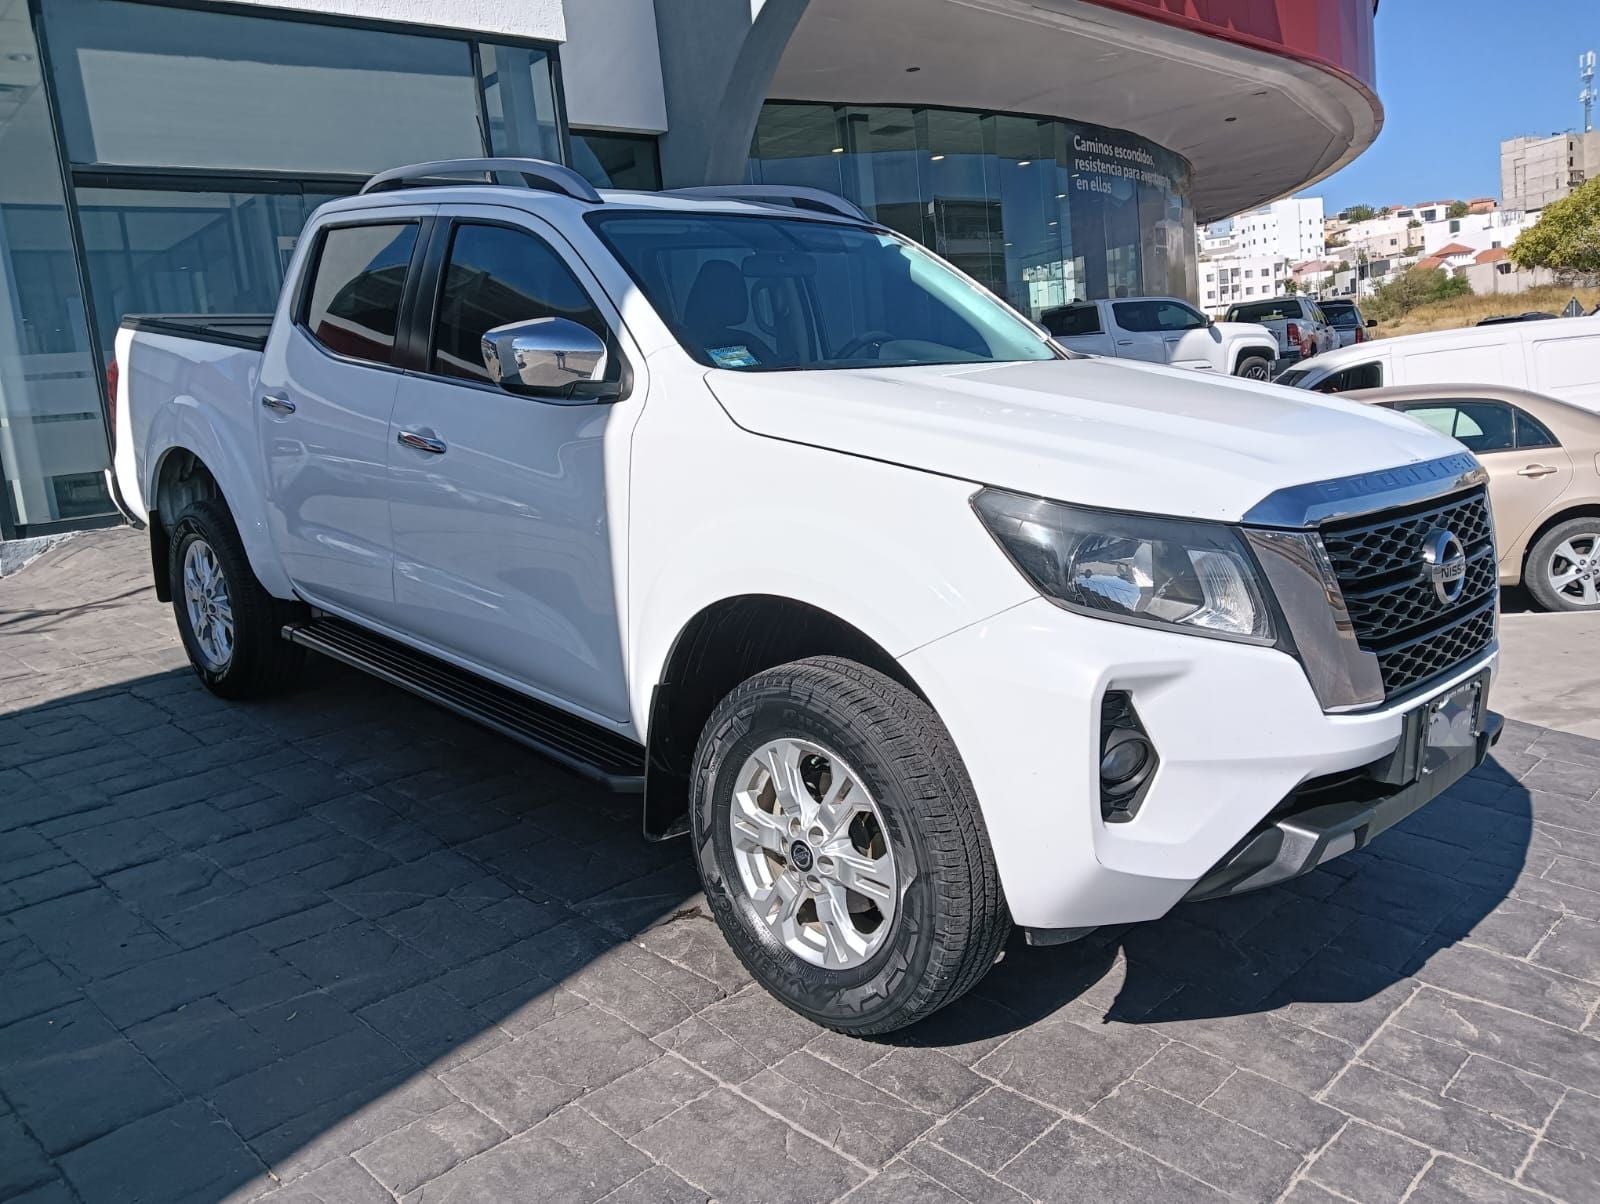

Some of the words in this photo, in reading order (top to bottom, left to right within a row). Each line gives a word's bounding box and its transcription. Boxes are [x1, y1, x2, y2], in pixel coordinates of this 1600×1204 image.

[1073, 135, 1113, 156] Caminos
[1075, 156, 1122, 177] resistencia
[1123, 166, 1140, 181] para
[1076, 178, 1089, 191] en
[1090, 176, 1112, 194] ellos
[1441, 562, 1464, 578] NISS
